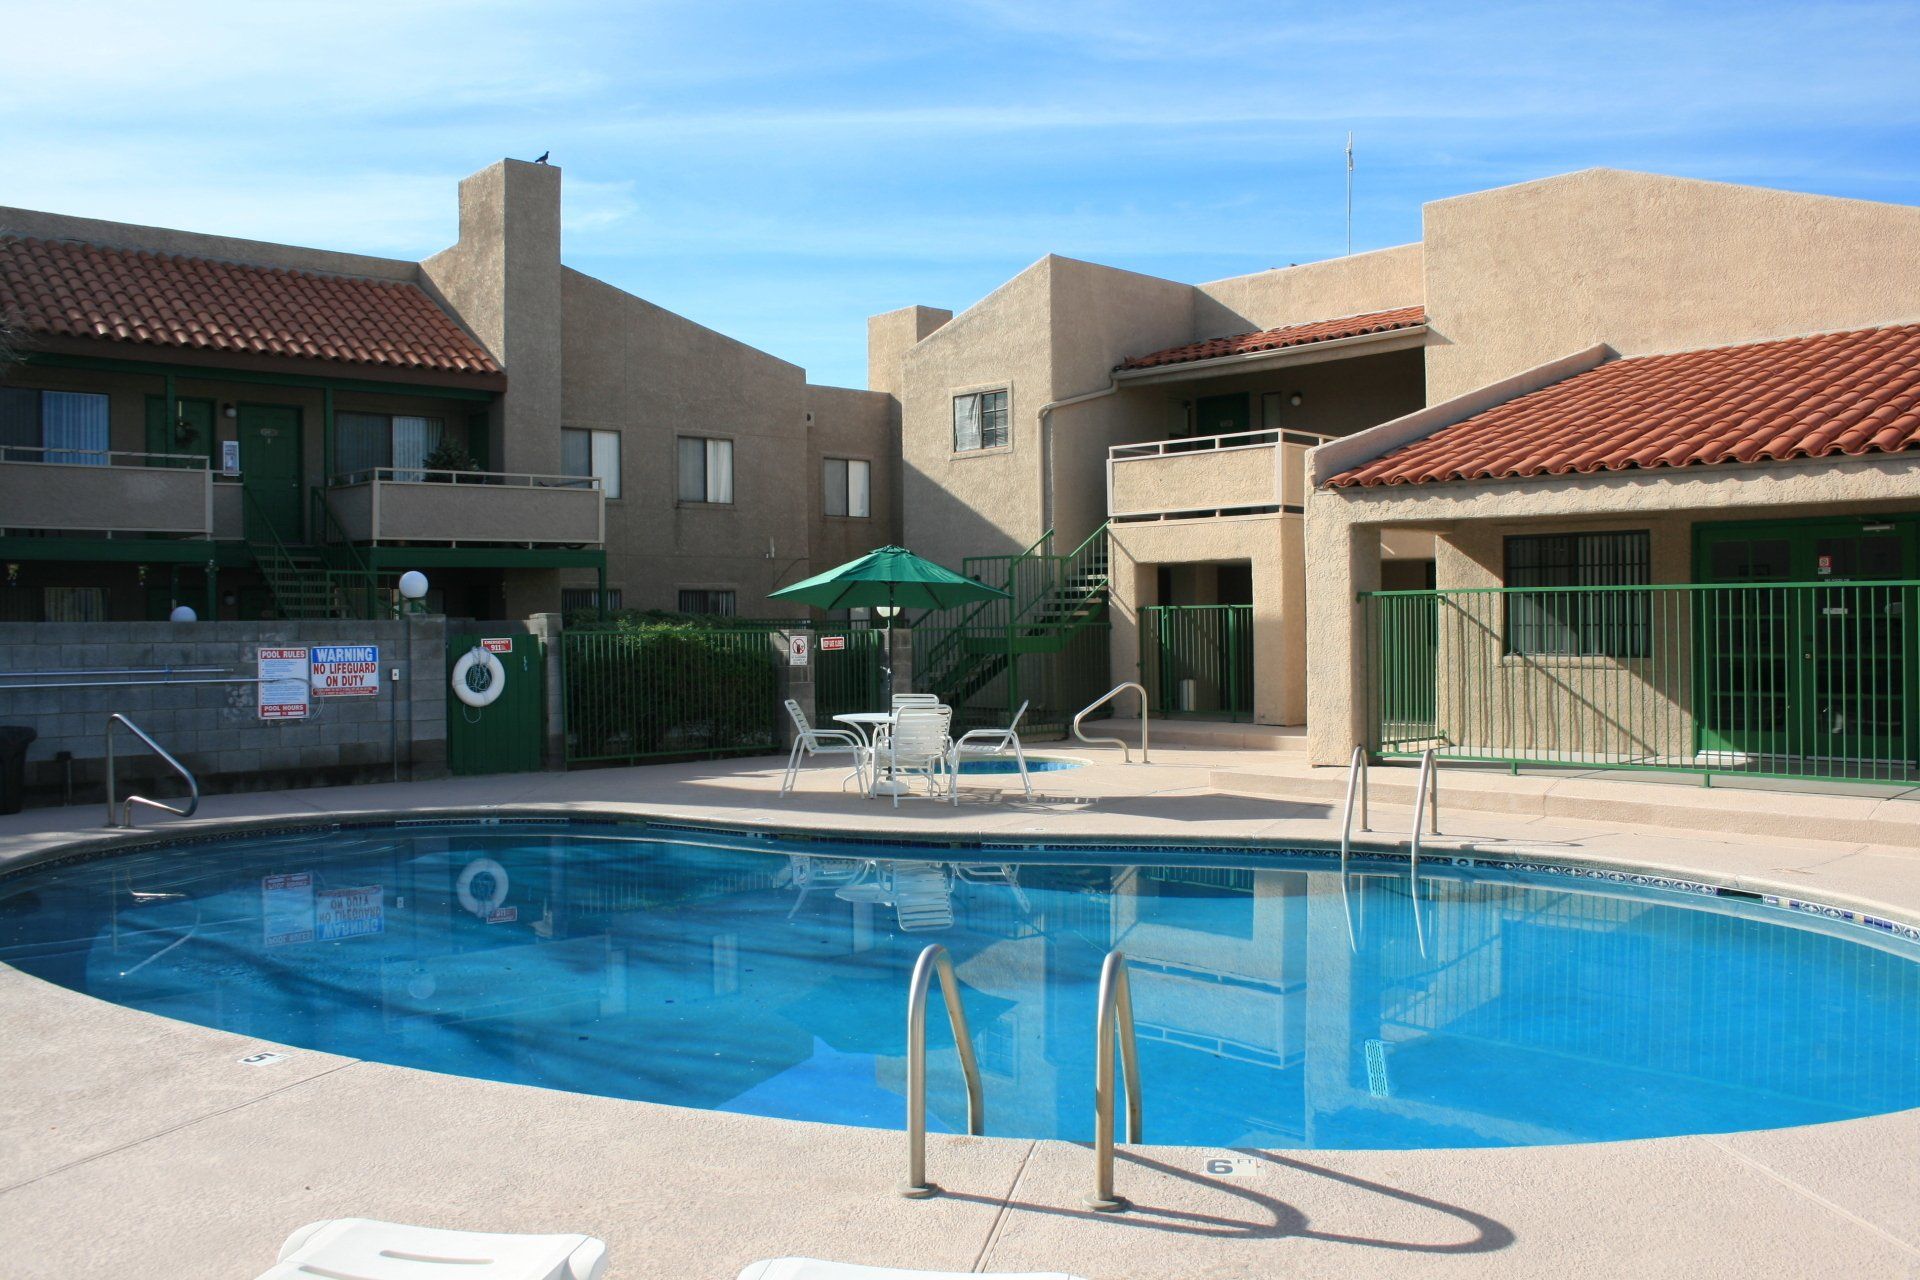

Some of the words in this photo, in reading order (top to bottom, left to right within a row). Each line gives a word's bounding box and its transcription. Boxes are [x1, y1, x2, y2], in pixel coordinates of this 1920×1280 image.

[262, 650, 280, 659] POOL
[283, 650, 305, 658] RULES
[317, 648, 373, 662] WARNING
[313, 663, 326, 675] NO
[329, 663, 376, 674] LIFEGUARD
[326, 676, 338, 687] ON
[342, 675, 365, 686] DUTY
[1207, 1159, 1233, 1174] 6
